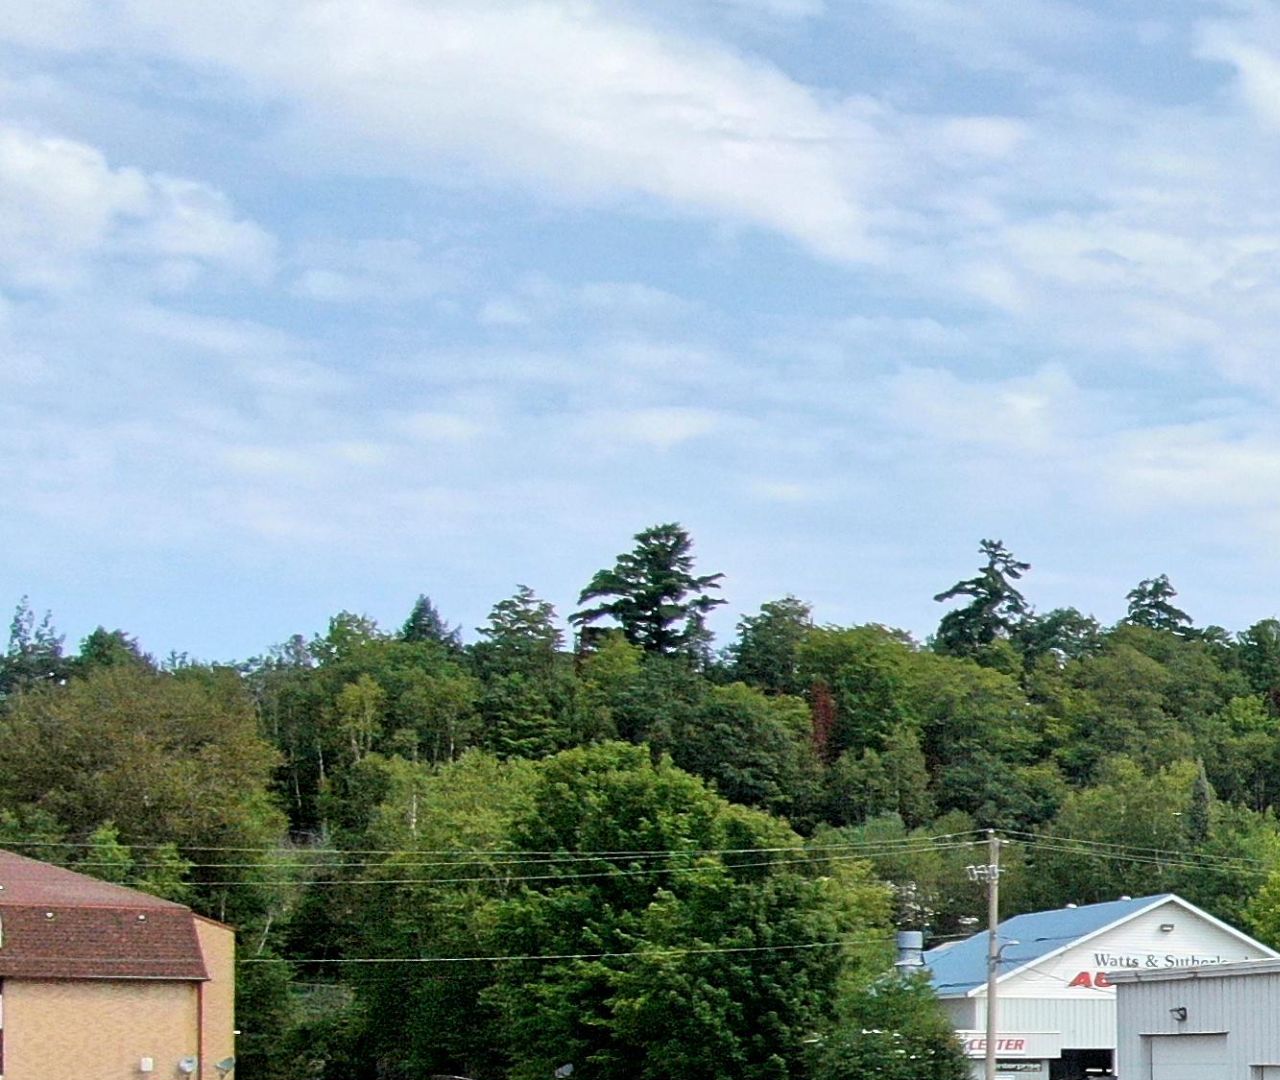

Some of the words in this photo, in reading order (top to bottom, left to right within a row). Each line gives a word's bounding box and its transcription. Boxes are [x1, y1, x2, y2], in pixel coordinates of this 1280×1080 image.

[1094, 953, 1138, 967] Watts
[1145, 954, 1158, 967] &
[969, 1039, 1025, 1051] CETER
[995, 1063, 1042, 1071] nterprise
